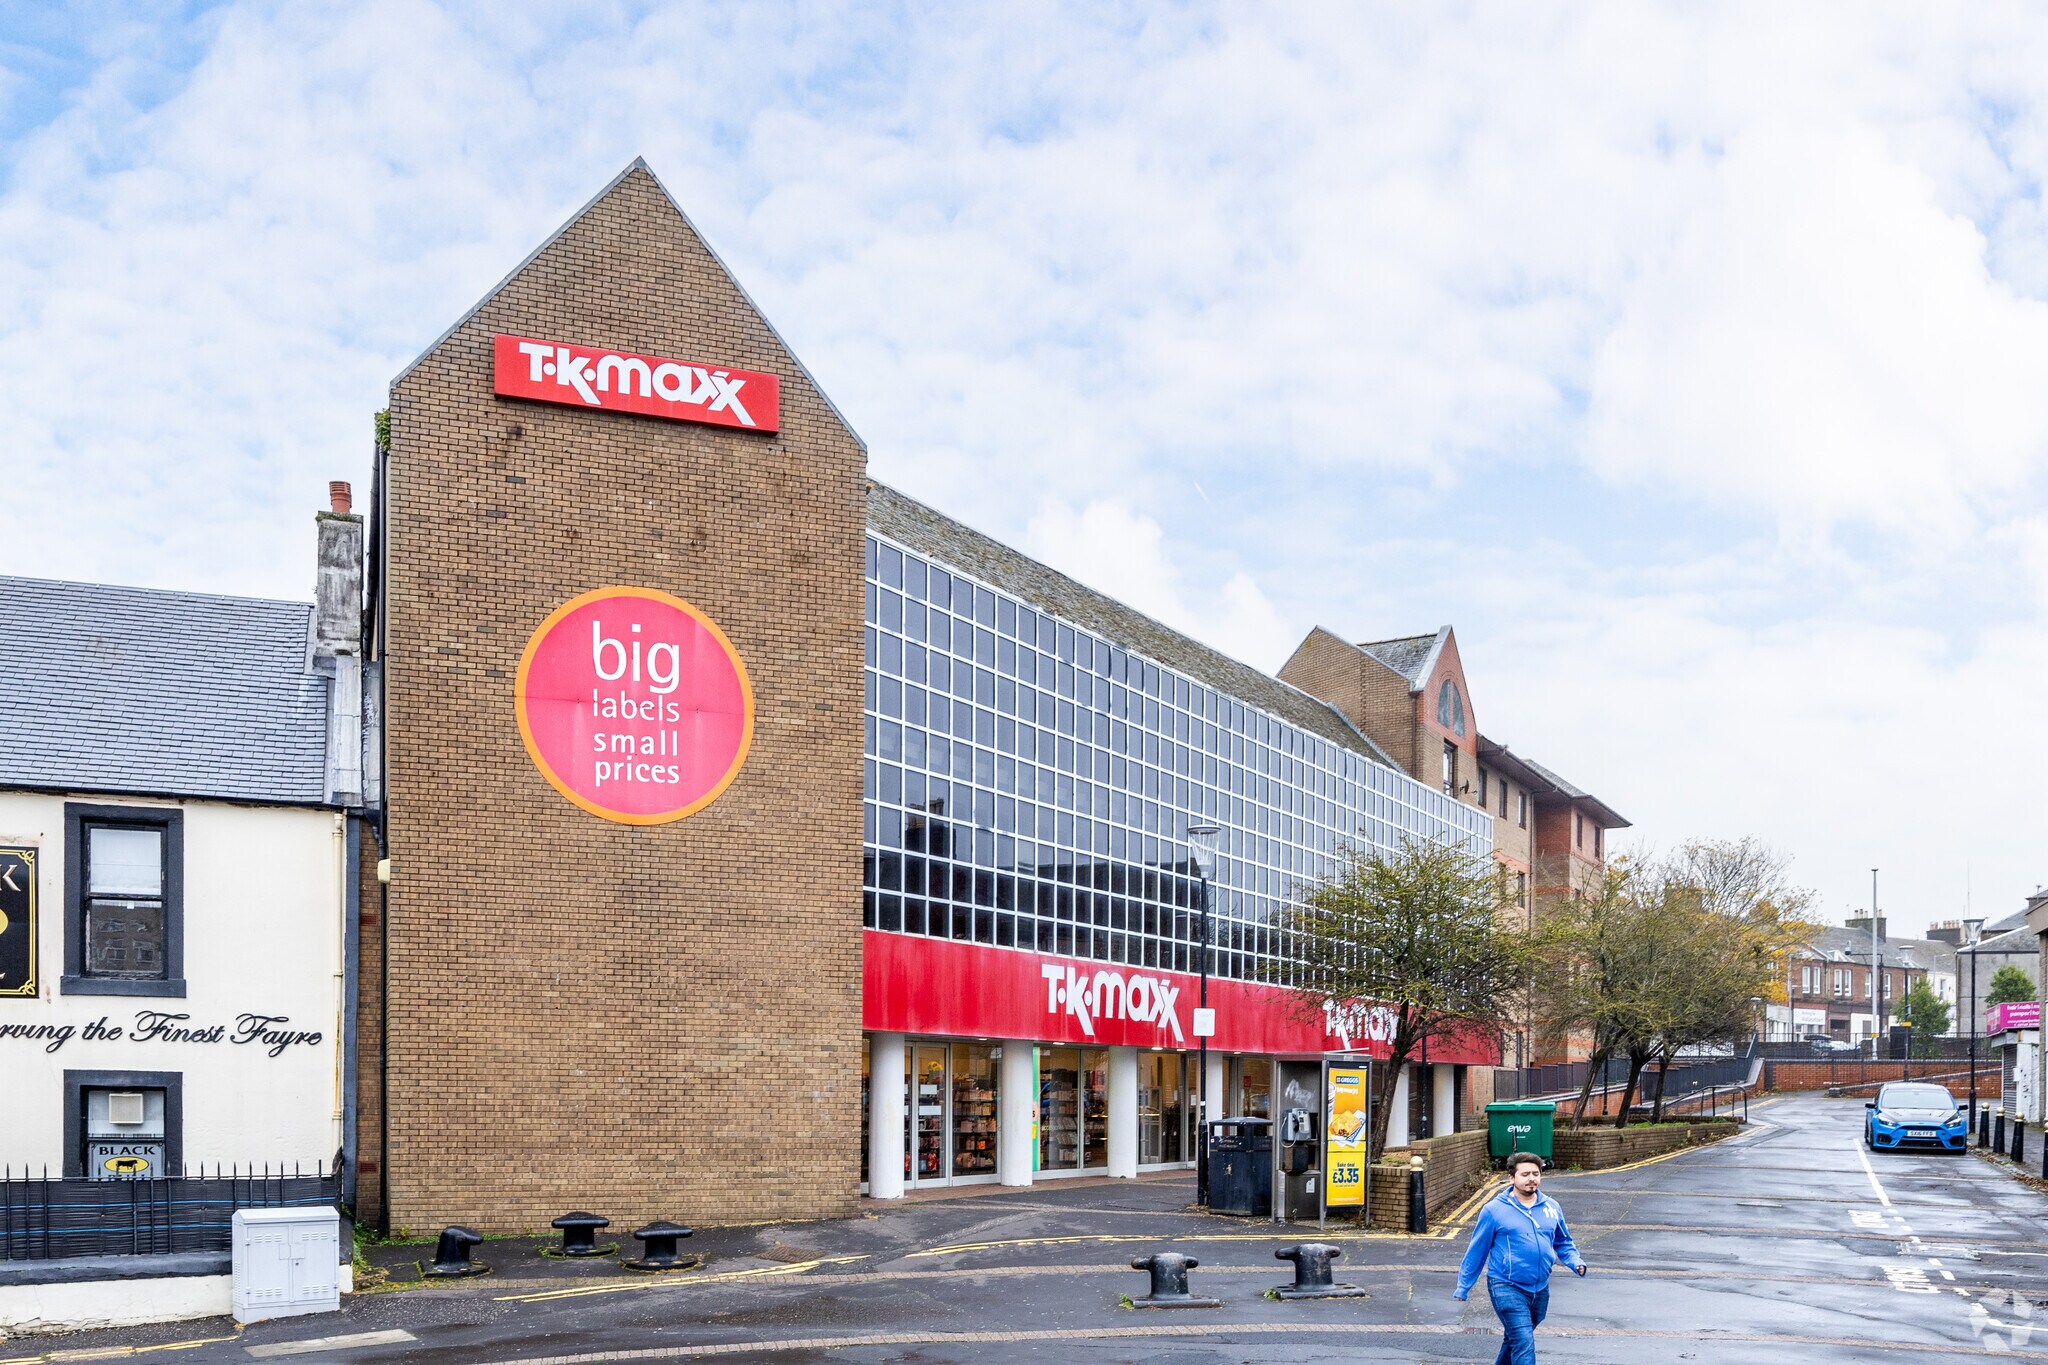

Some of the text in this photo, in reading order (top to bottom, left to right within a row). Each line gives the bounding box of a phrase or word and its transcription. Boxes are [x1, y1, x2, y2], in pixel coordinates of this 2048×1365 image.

[592, 620, 680, 694] big
[593, 688, 680, 722] labels
[593, 729, 678, 756] small
[595, 755, 680, 787] prices
[81, 1016, 123, 1041] the
[129, 1010, 225, 1043] Finest
[230, 1013, 323, 1058] Fayre
[1507, 1124, 1532, 1133] enva
[99, 1146, 155, 1155] BLACK
[1332, 1167, 1359, 1183] £3.35
